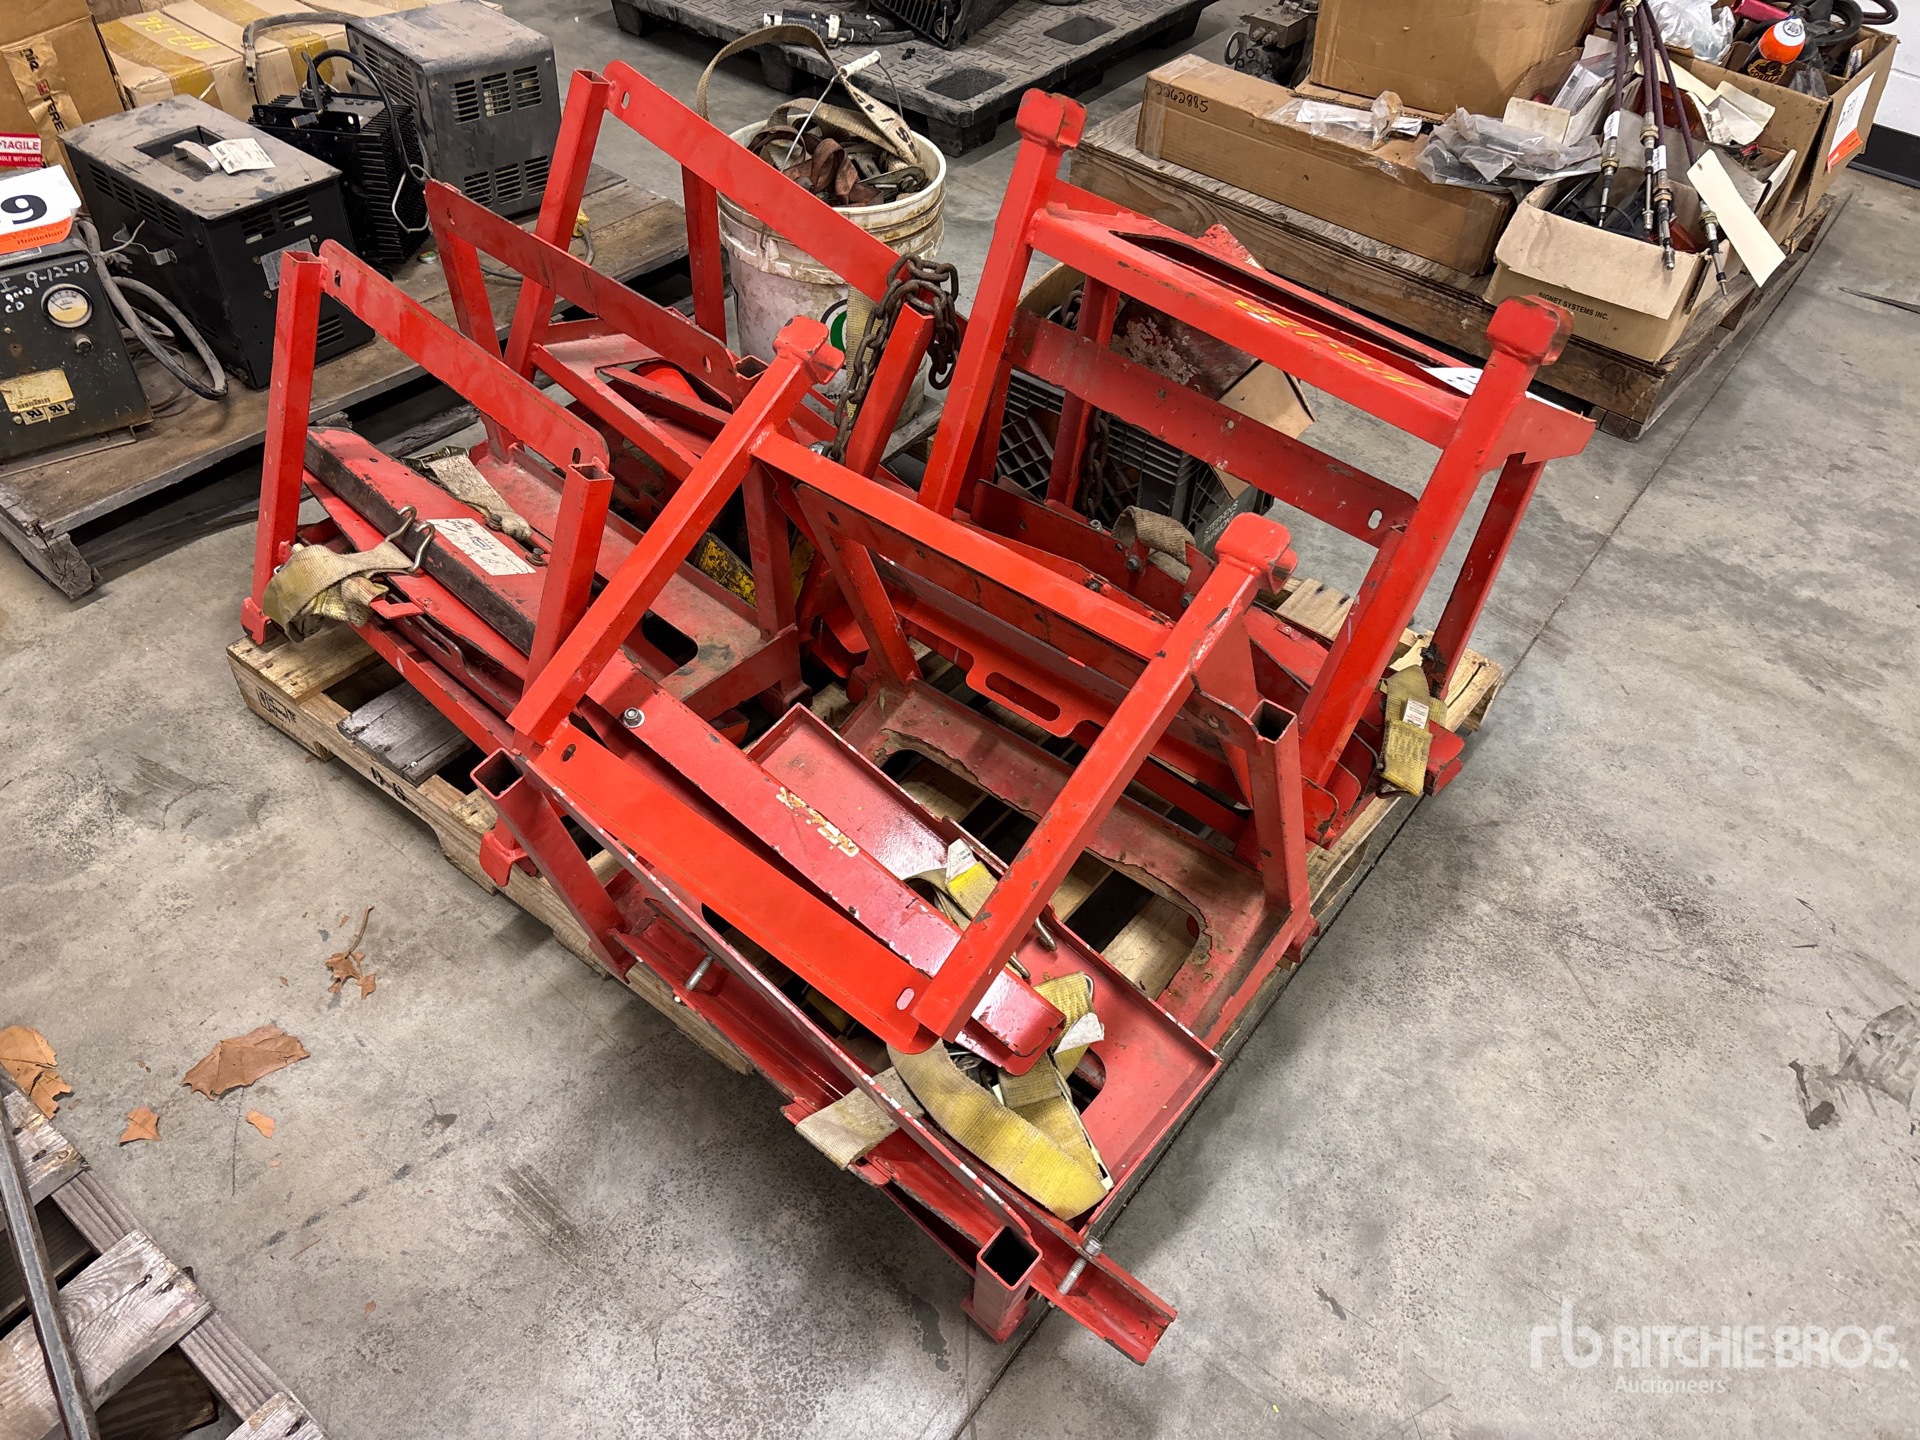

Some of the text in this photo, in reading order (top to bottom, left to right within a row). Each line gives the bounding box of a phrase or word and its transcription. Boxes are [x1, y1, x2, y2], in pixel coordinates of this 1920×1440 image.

[43, 94, 67, 133] TERE
[0, 140, 40, 152] RAGILE
[28, 156, 41, 164] CARE
[0, 194, 48, 225] 9
[26, 260, 90, 288] 9-12-13
[1538, 291, 1609, 321] SIGNET SYSTEMS INC.
